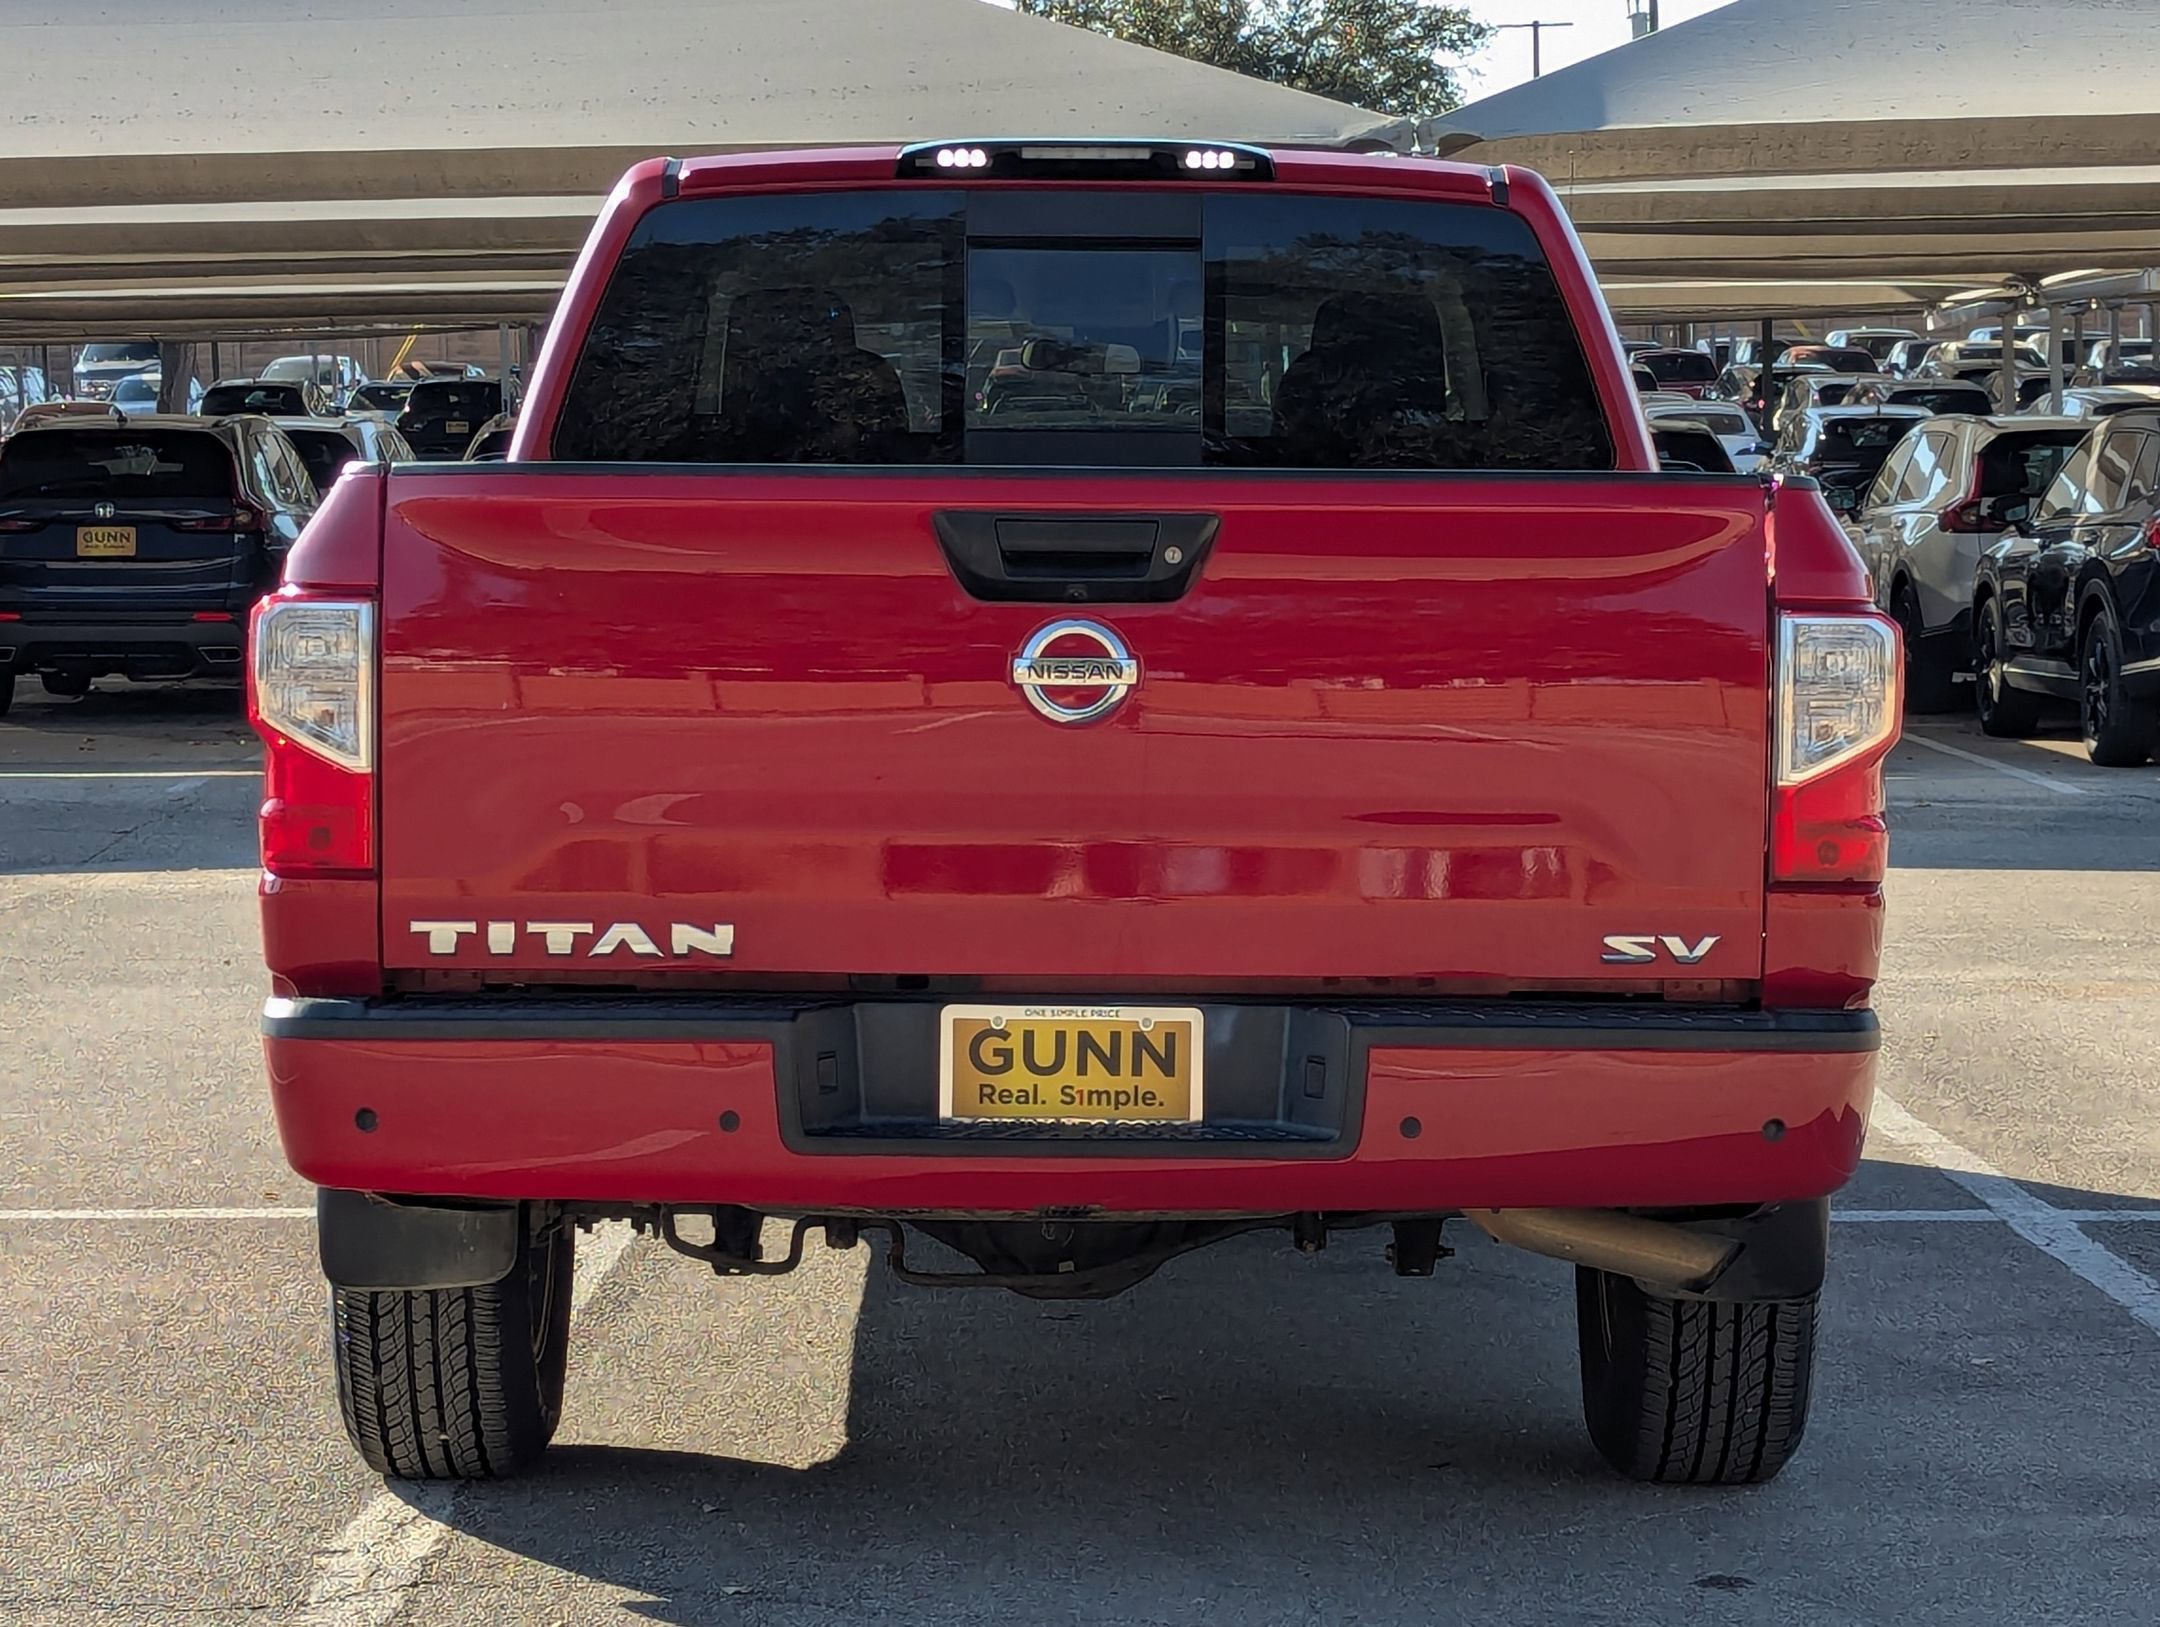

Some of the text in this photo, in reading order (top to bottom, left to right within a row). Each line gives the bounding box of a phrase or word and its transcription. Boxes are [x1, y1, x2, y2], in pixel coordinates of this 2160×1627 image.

[1027, 663, 1125, 680] NISSAN
[410, 920, 734, 957] TITAN
[1601, 935, 1721, 963] SV
[1024, 1008, 1046, 1017] ONE
[1091, 1009, 1120, 1018] PRICE
[969, 1028, 1176, 1077] GUNN
[979, 1083, 1047, 1105] Real.
